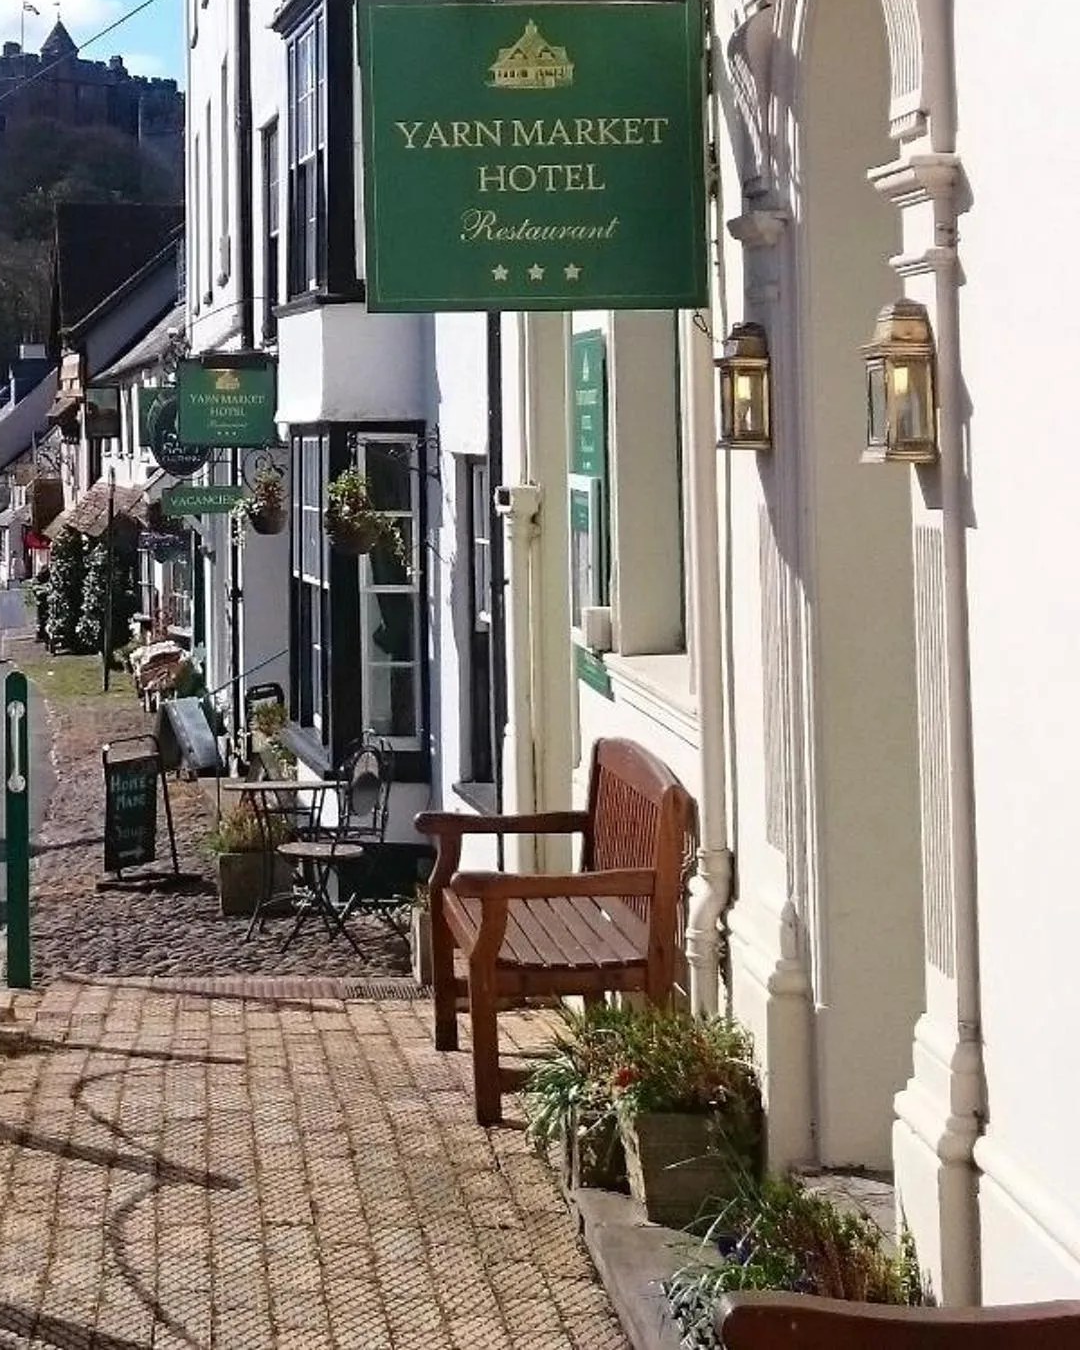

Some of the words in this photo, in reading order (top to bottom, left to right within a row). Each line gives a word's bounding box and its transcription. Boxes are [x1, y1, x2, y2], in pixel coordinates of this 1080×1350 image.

[395, 120, 503, 149] YARN
[512, 117, 669, 147] MARKET
[478, 163, 606, 192] HOTEL
[459, 208, 621, 242] Restaurant
